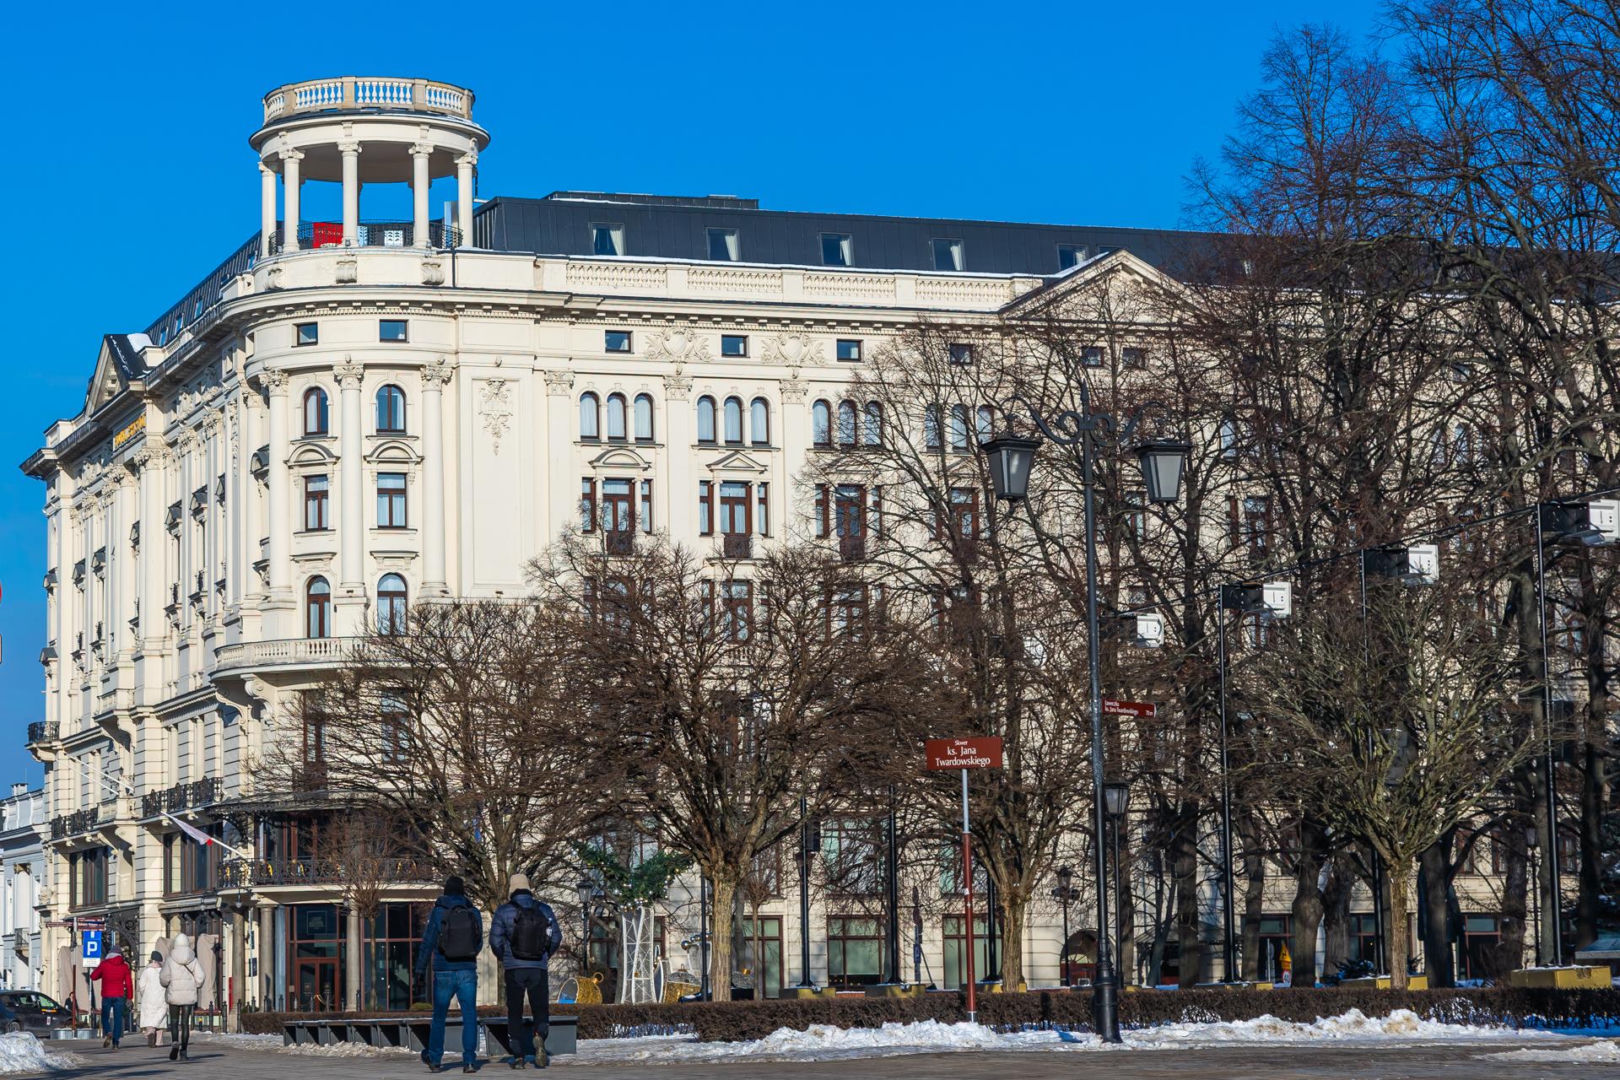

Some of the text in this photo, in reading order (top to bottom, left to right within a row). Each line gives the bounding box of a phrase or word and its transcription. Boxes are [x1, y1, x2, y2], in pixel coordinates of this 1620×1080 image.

[947, 747, 976, 756] ks. Jana
[936, 756, 991, 767] Twardowskiego
[87, 941, 98, 955] P
